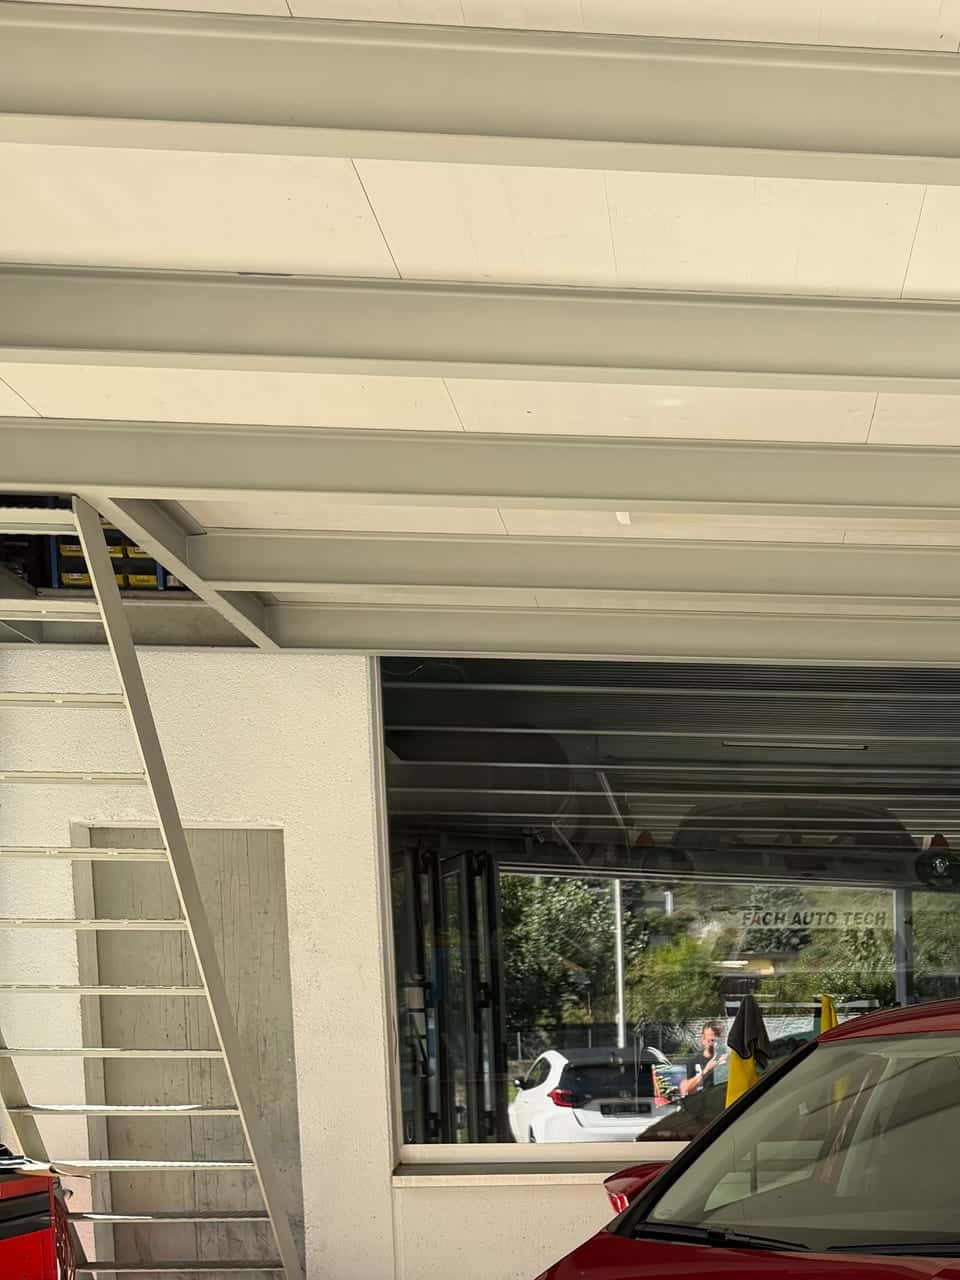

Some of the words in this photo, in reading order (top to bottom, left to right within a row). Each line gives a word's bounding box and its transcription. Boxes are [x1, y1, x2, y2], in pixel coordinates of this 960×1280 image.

[742, 911, 786, 926] FACH
[791, 911, 837, 926] AUTO
[843, 911, 886, 926] TECH
